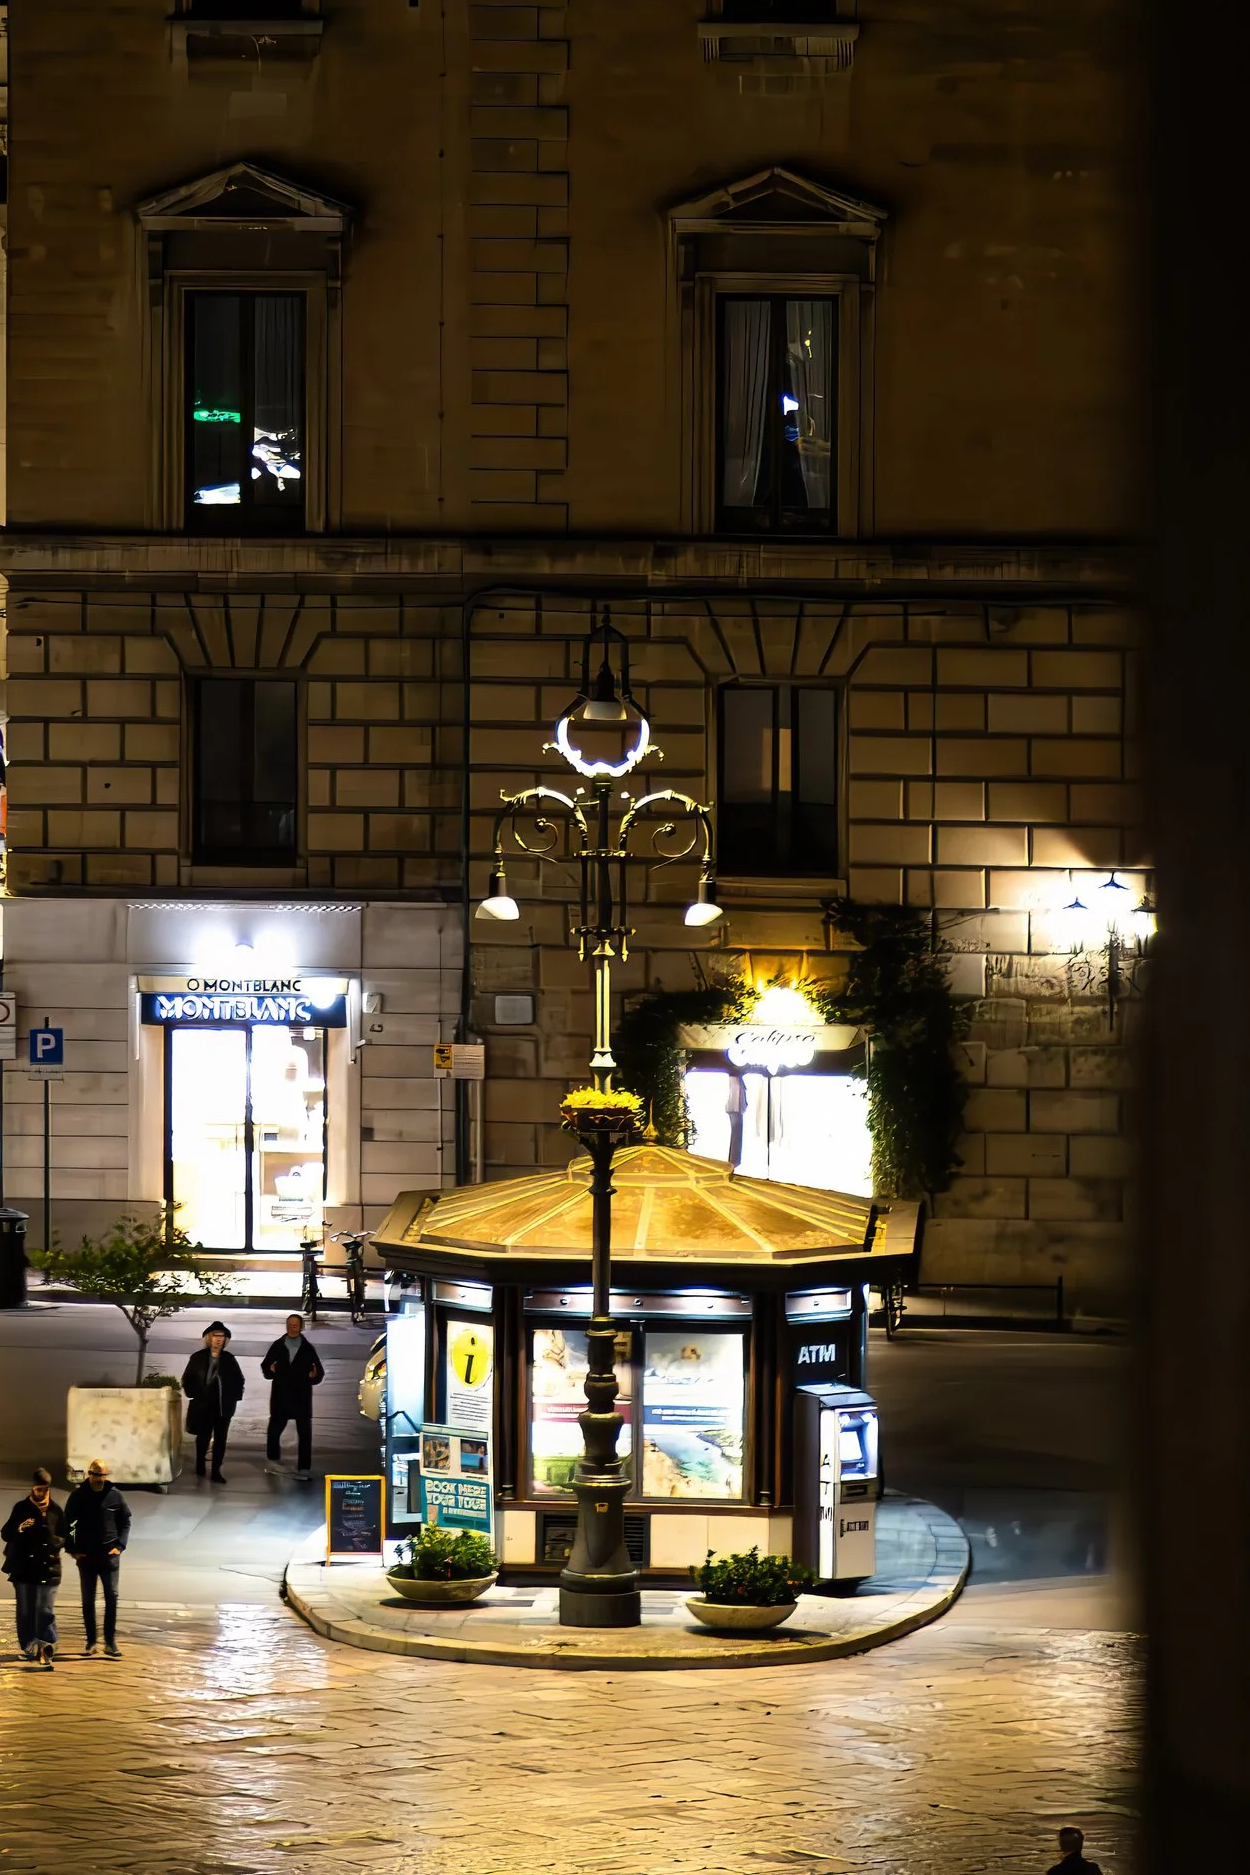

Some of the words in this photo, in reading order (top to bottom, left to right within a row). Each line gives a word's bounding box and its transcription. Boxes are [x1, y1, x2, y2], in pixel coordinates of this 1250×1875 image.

[203, 978, 301, 993] MONTBLANC
[157, 995, 312, 1021] MONTBLANC
[36, 1033, 56, 1059] P
[797, 1343, 836, 1365] ATM
[425, 1479, 457, 1493] BOOK
